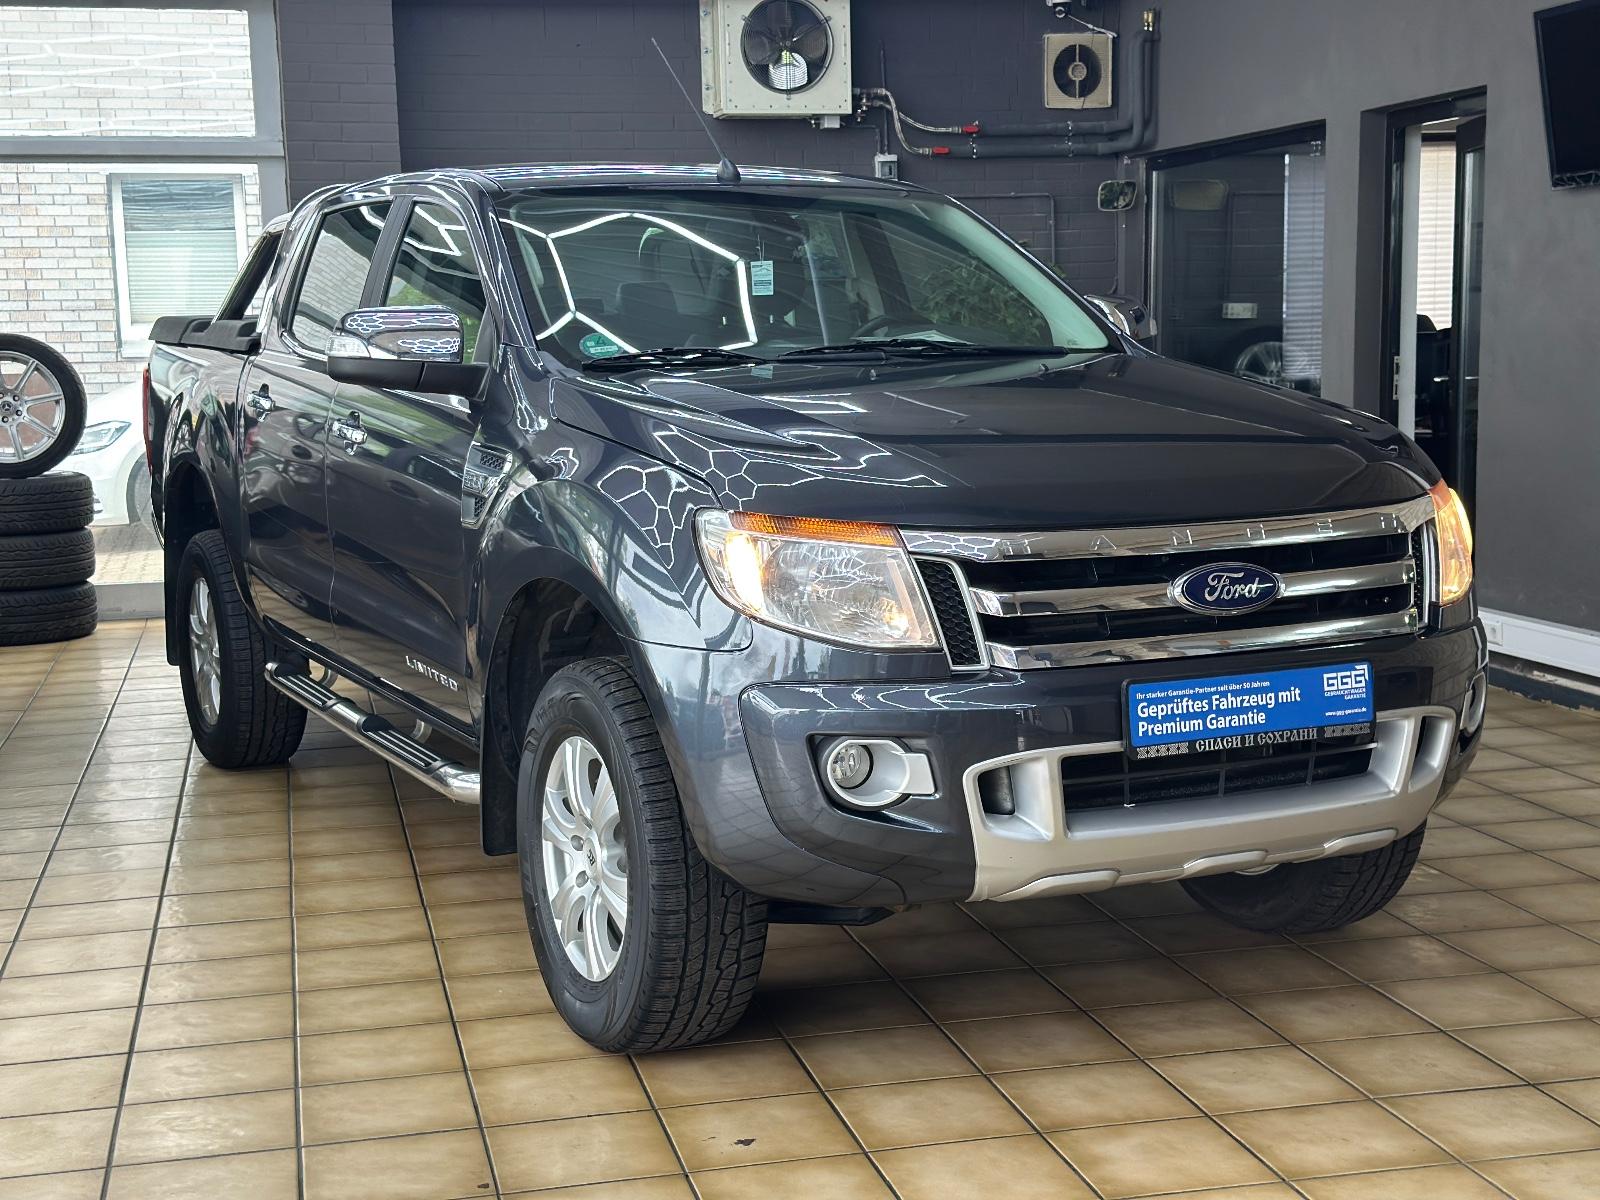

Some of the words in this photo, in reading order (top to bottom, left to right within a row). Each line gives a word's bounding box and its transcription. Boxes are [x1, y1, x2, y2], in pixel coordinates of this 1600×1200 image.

[1204, 572, 1274, 602] Ford
[405, 655, 458, 692] LIMITED
[1323, 669, 1366, 691] GGG
[1137, 697, 1209, 720] Geprüftes
[1212, 692, 1276, 710] Fahrzeug
[1278, 686, 1301, 703] mit
[1146, 691, 1168, 699] starker
[1168, 686, 1217, 697] Garantie-Partner
[1217, 684, 1229, 692] seit
[1229, 682, 1242, 690] über
[1252, 680, 1271, 689] Jahren
[1138, 717, 1203, 737] Premium
[1206, 708, 1266, 729] Garantie
[1195, 735, 1242, 752] СПАСИ
[1244, 734, 1255, 747] И
[1257, 727, 1318, 745] СОХРАНИ
